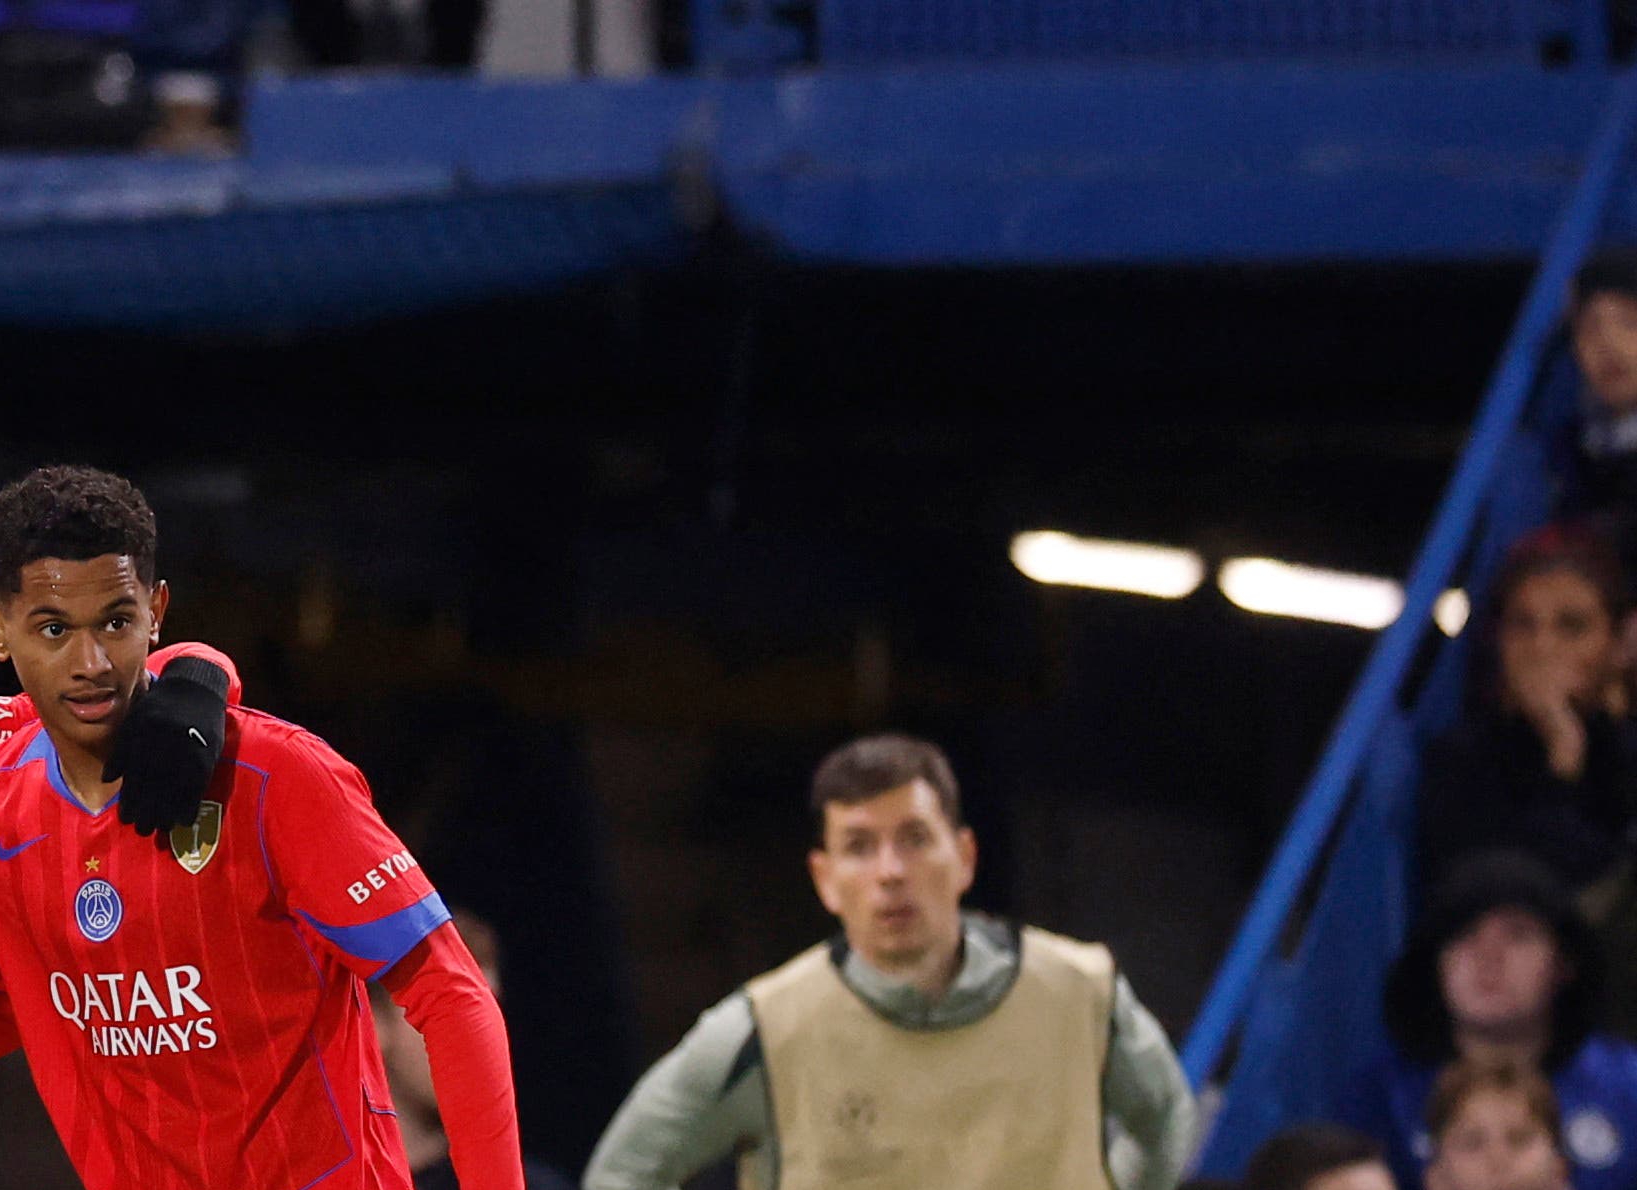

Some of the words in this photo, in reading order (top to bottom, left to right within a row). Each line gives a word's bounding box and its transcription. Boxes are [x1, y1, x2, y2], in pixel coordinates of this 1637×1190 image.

[81, 883, 112, 899] PARIS
[50, 964, 212, 1031] QATAR
[91, 1016, 217, 1057] AIRWAYS
